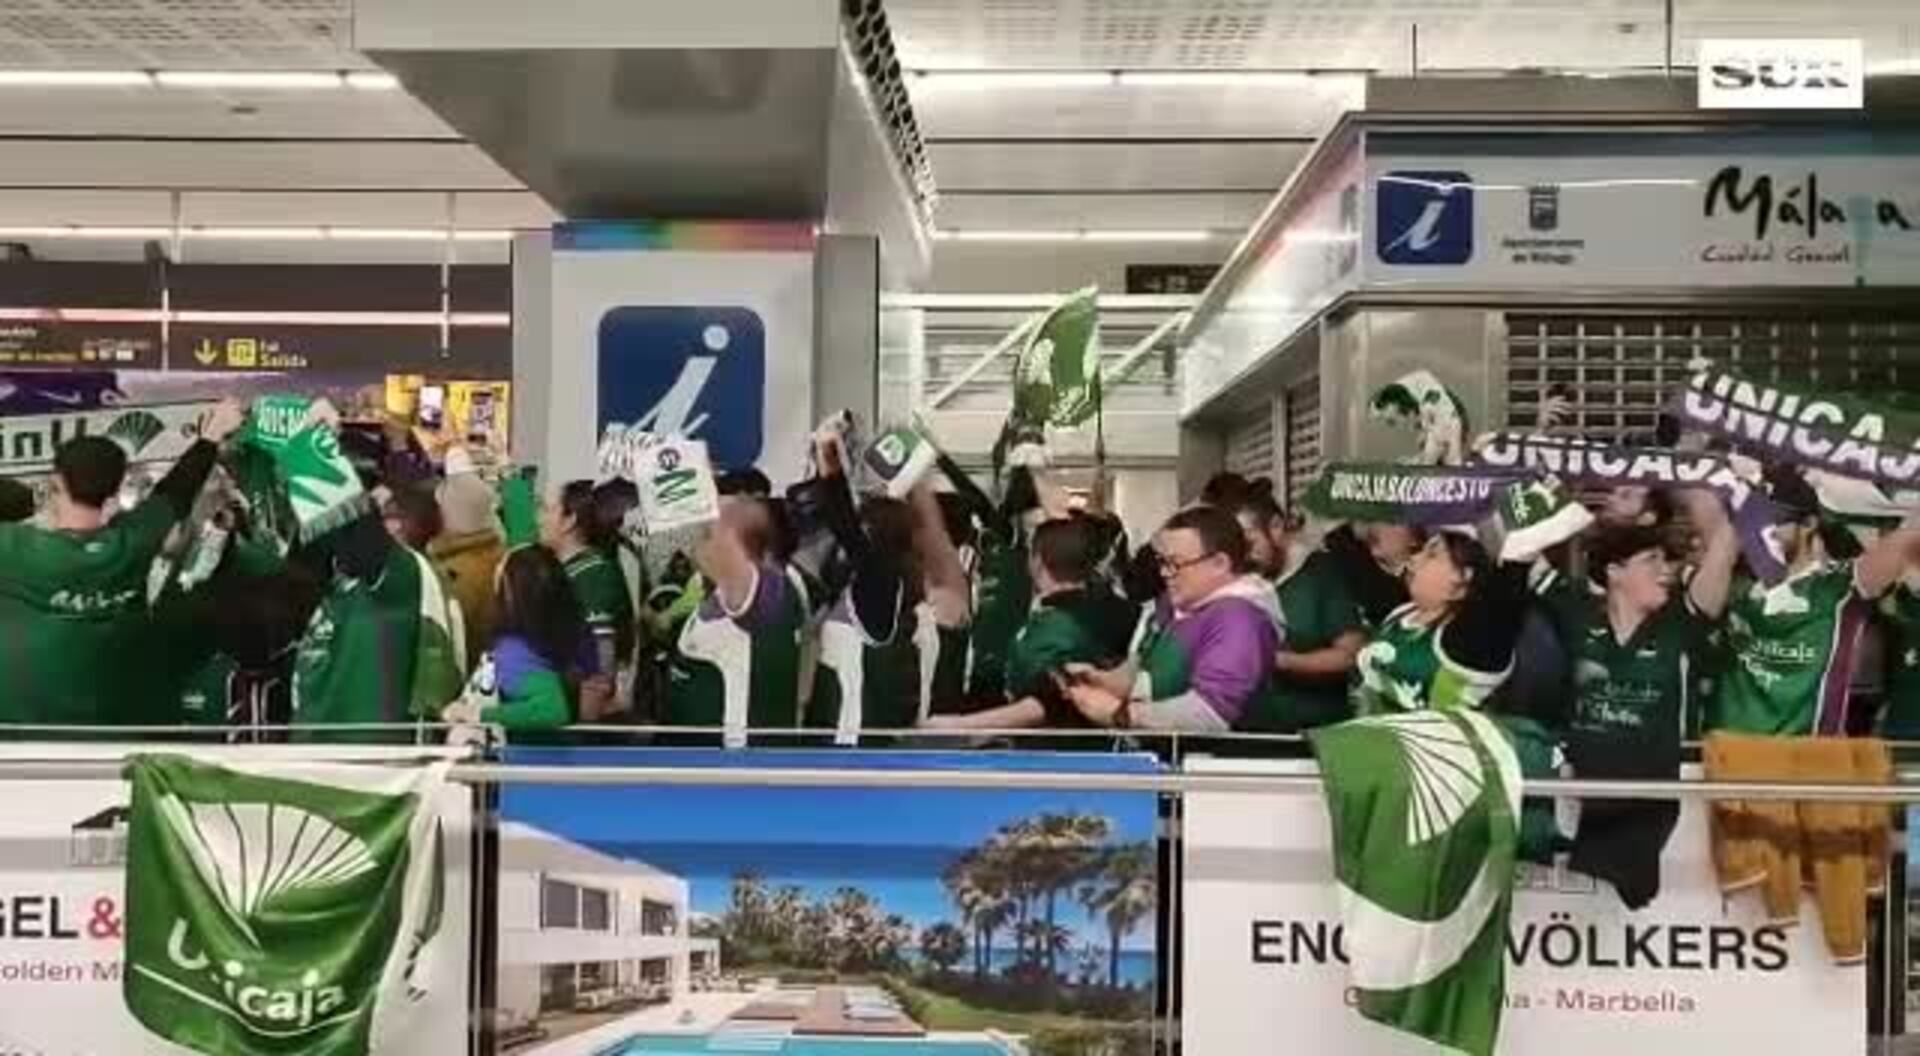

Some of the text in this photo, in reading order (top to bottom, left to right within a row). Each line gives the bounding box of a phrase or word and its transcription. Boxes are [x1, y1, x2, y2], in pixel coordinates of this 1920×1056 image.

[1703, 165, 1911, 240] Málaa
[0, 896, 79, 938] EL
[1505, 911, 1790, 971] VÖLKERS
[167, 917, 346, 1025] Uicaja
[1556, 988, 1696, 1012] Marbella
